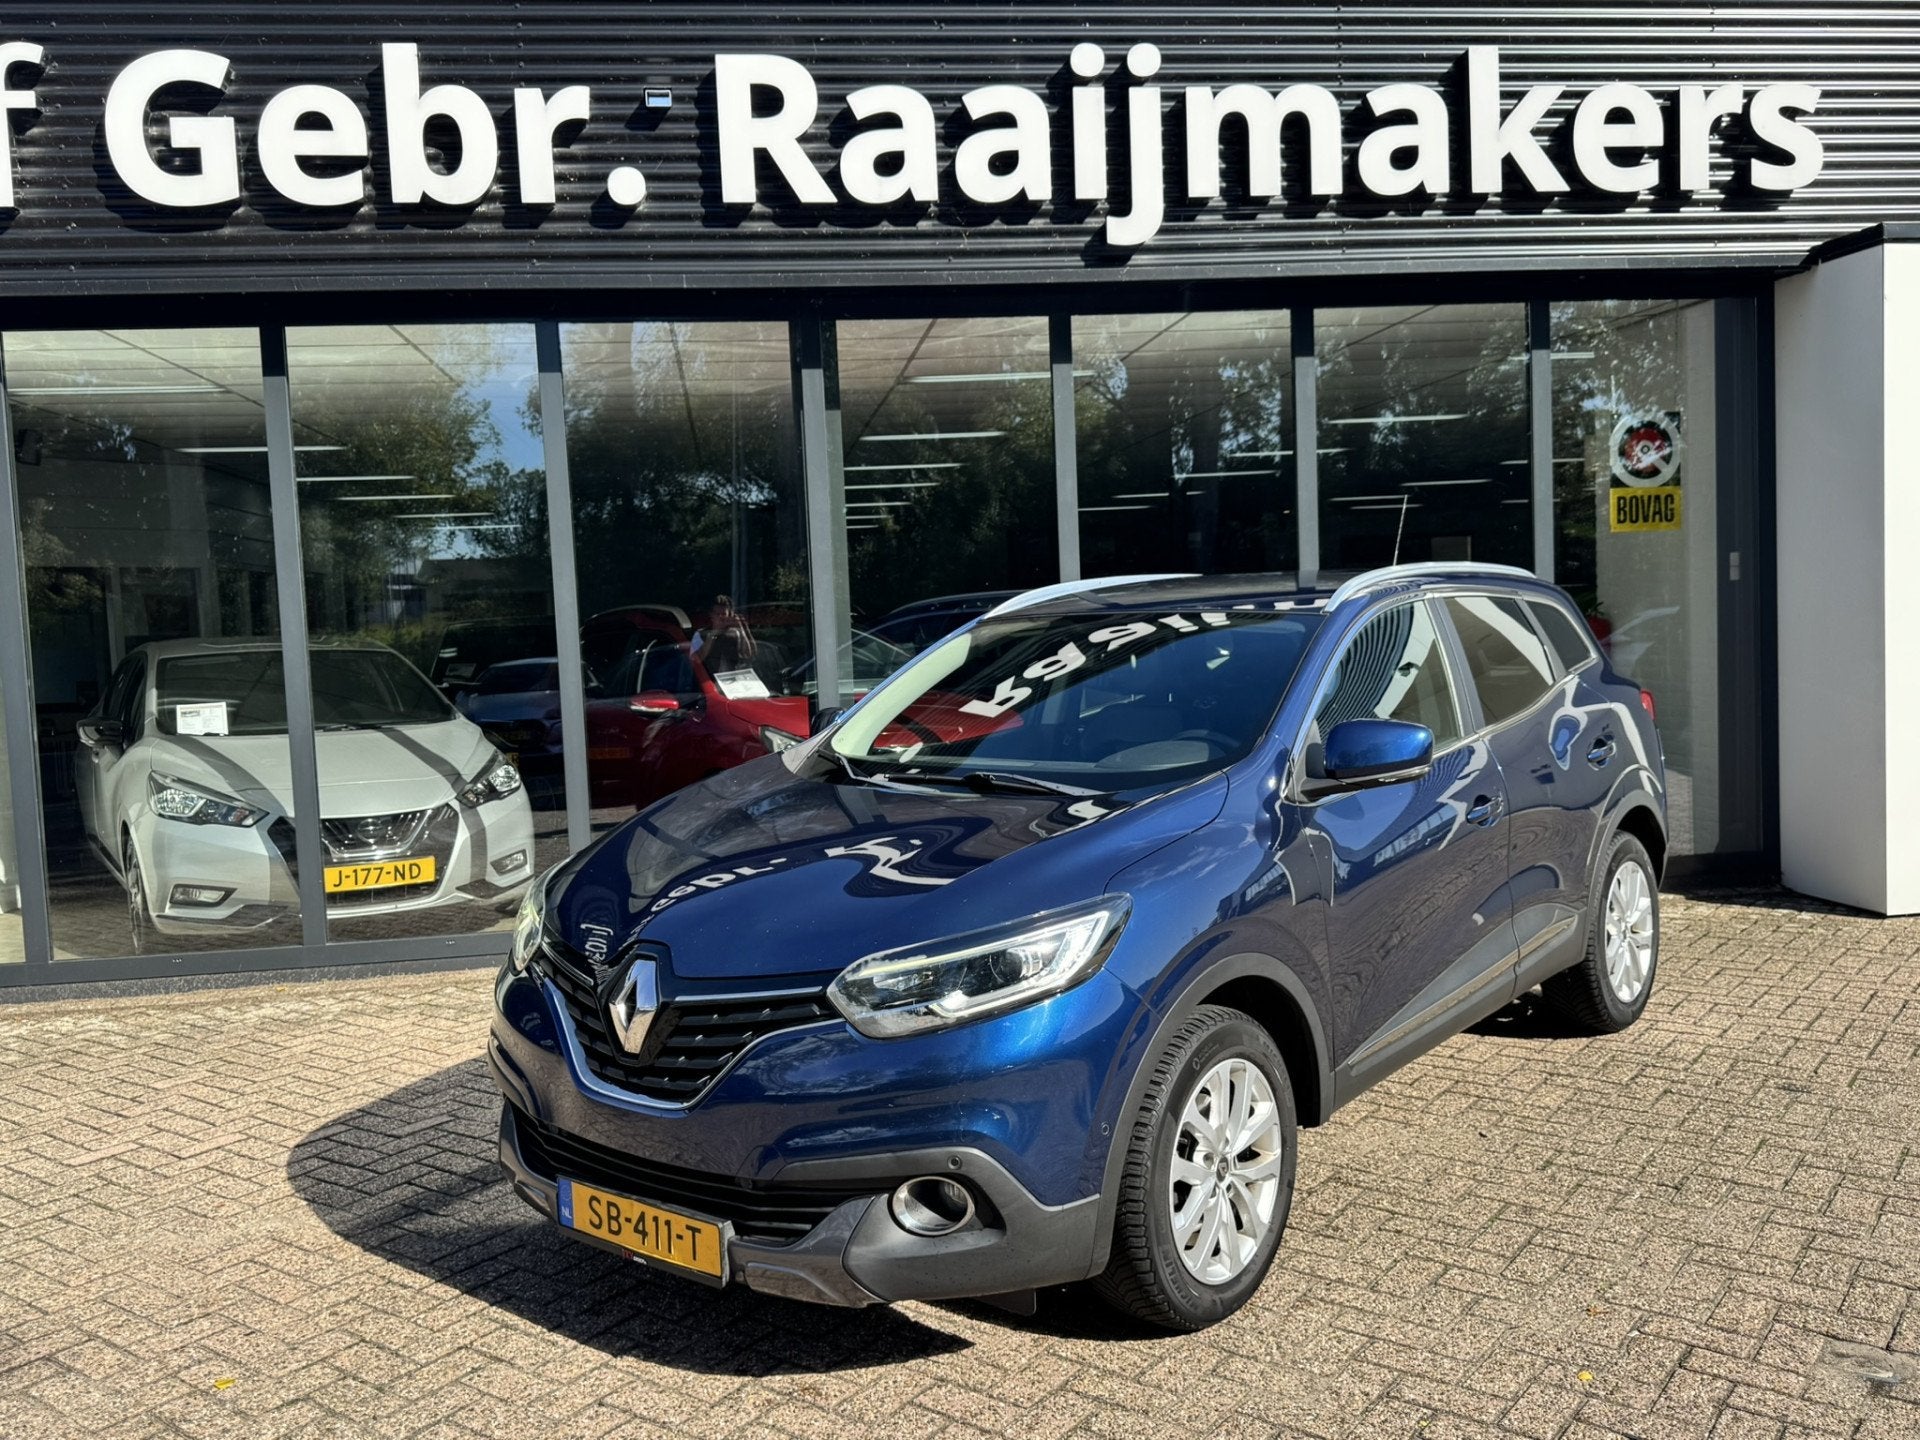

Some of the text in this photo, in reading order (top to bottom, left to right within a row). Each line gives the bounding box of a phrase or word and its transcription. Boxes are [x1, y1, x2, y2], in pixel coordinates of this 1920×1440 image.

[104, 42, 647, 207] Gebr.
[715, 42, 1824, 246] Raaijmakers
[1616, 493, 1675, 525] BOVAG
[333, 863, 421, 888] J-177-ND
[561, 1195, 702, 1262] NL SB-411-T
